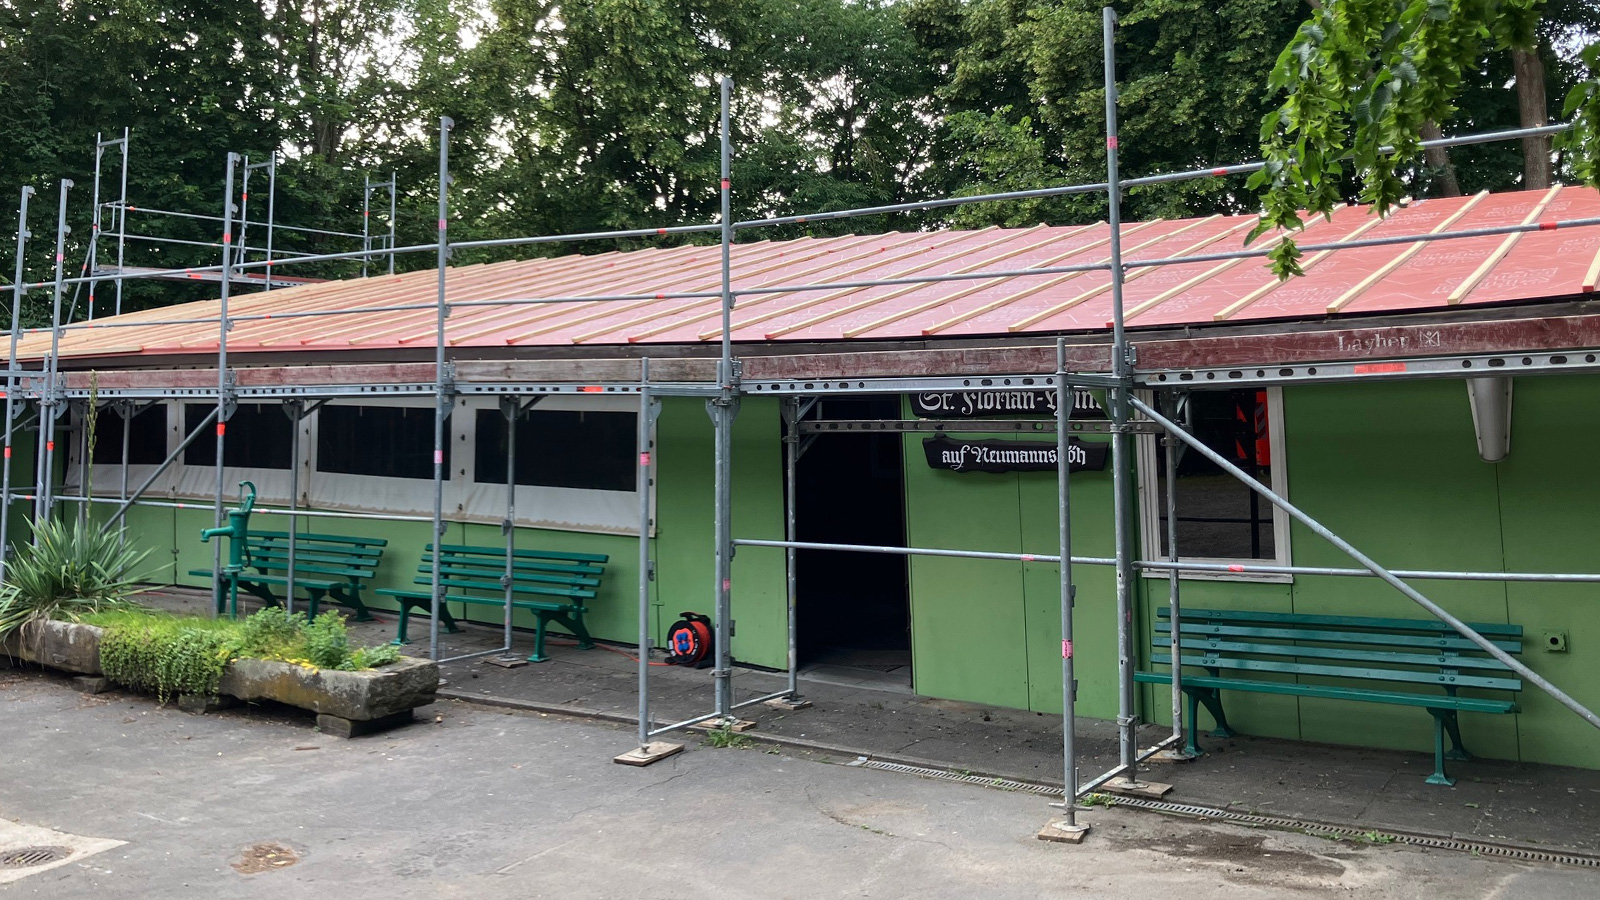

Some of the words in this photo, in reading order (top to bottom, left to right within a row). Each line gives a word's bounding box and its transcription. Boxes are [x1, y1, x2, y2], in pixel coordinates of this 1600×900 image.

[1338, 334, 1409, 354] Layher
[918, 391, 955, 410] St.
[942, 445, 970, 470] auf
[970, 445, 1086, 466] Neumannsöh
